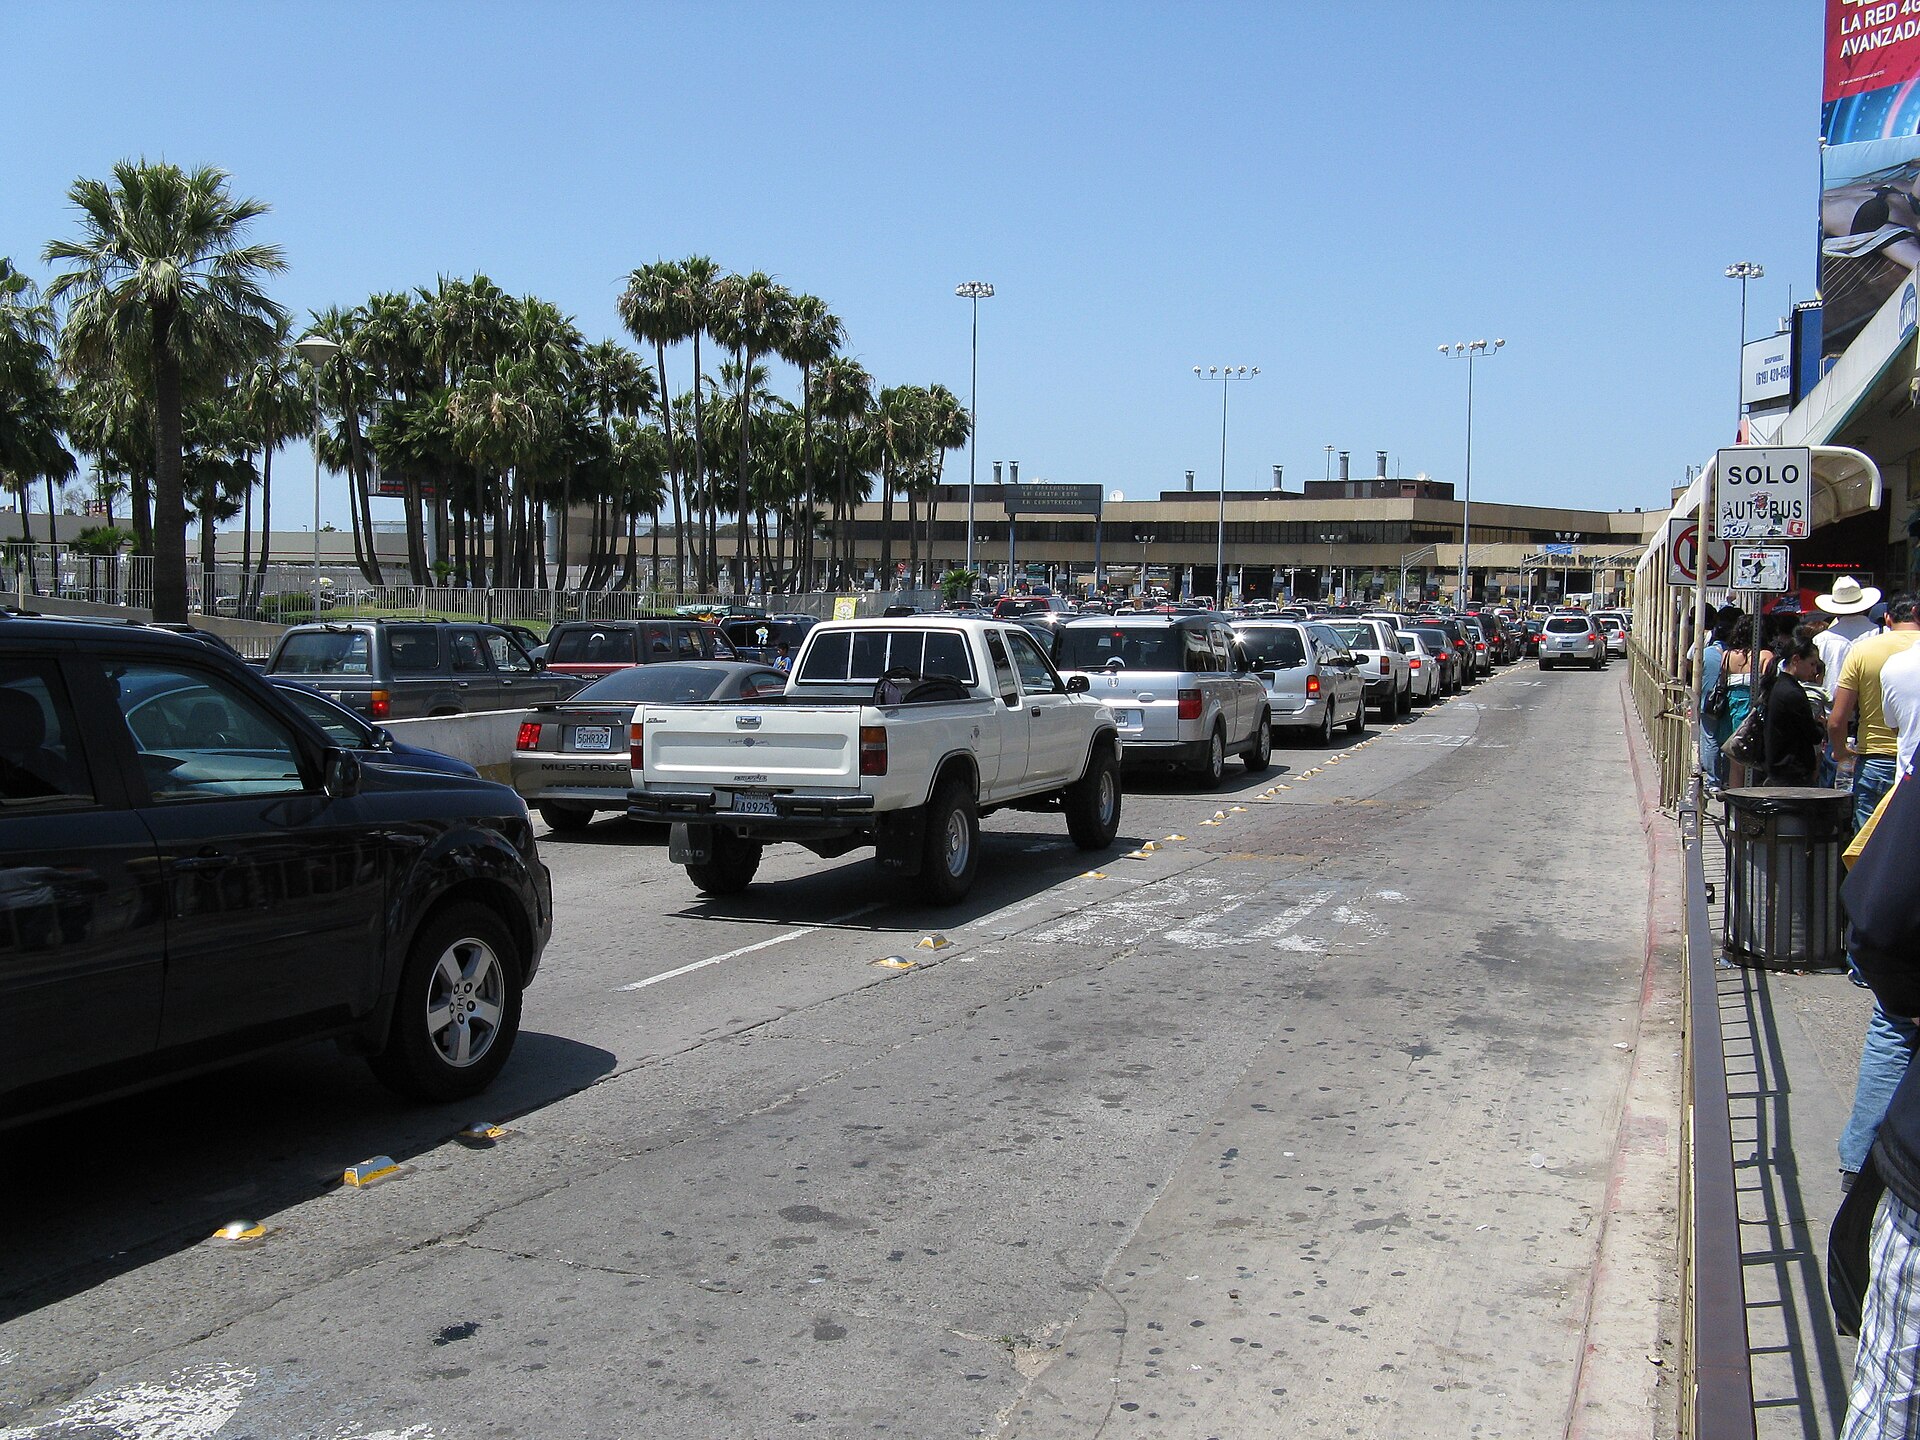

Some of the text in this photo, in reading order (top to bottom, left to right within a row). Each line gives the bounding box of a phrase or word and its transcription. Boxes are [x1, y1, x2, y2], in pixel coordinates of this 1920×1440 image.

[1841, 13, 1861, 35] LA
[1865, 3, 1896, 28] RED
[1728, 465, 1799, 485] SOLO
[578, 733, 609, 744] 5GHR323
[541, 763, 628, 772] MUSTANG
